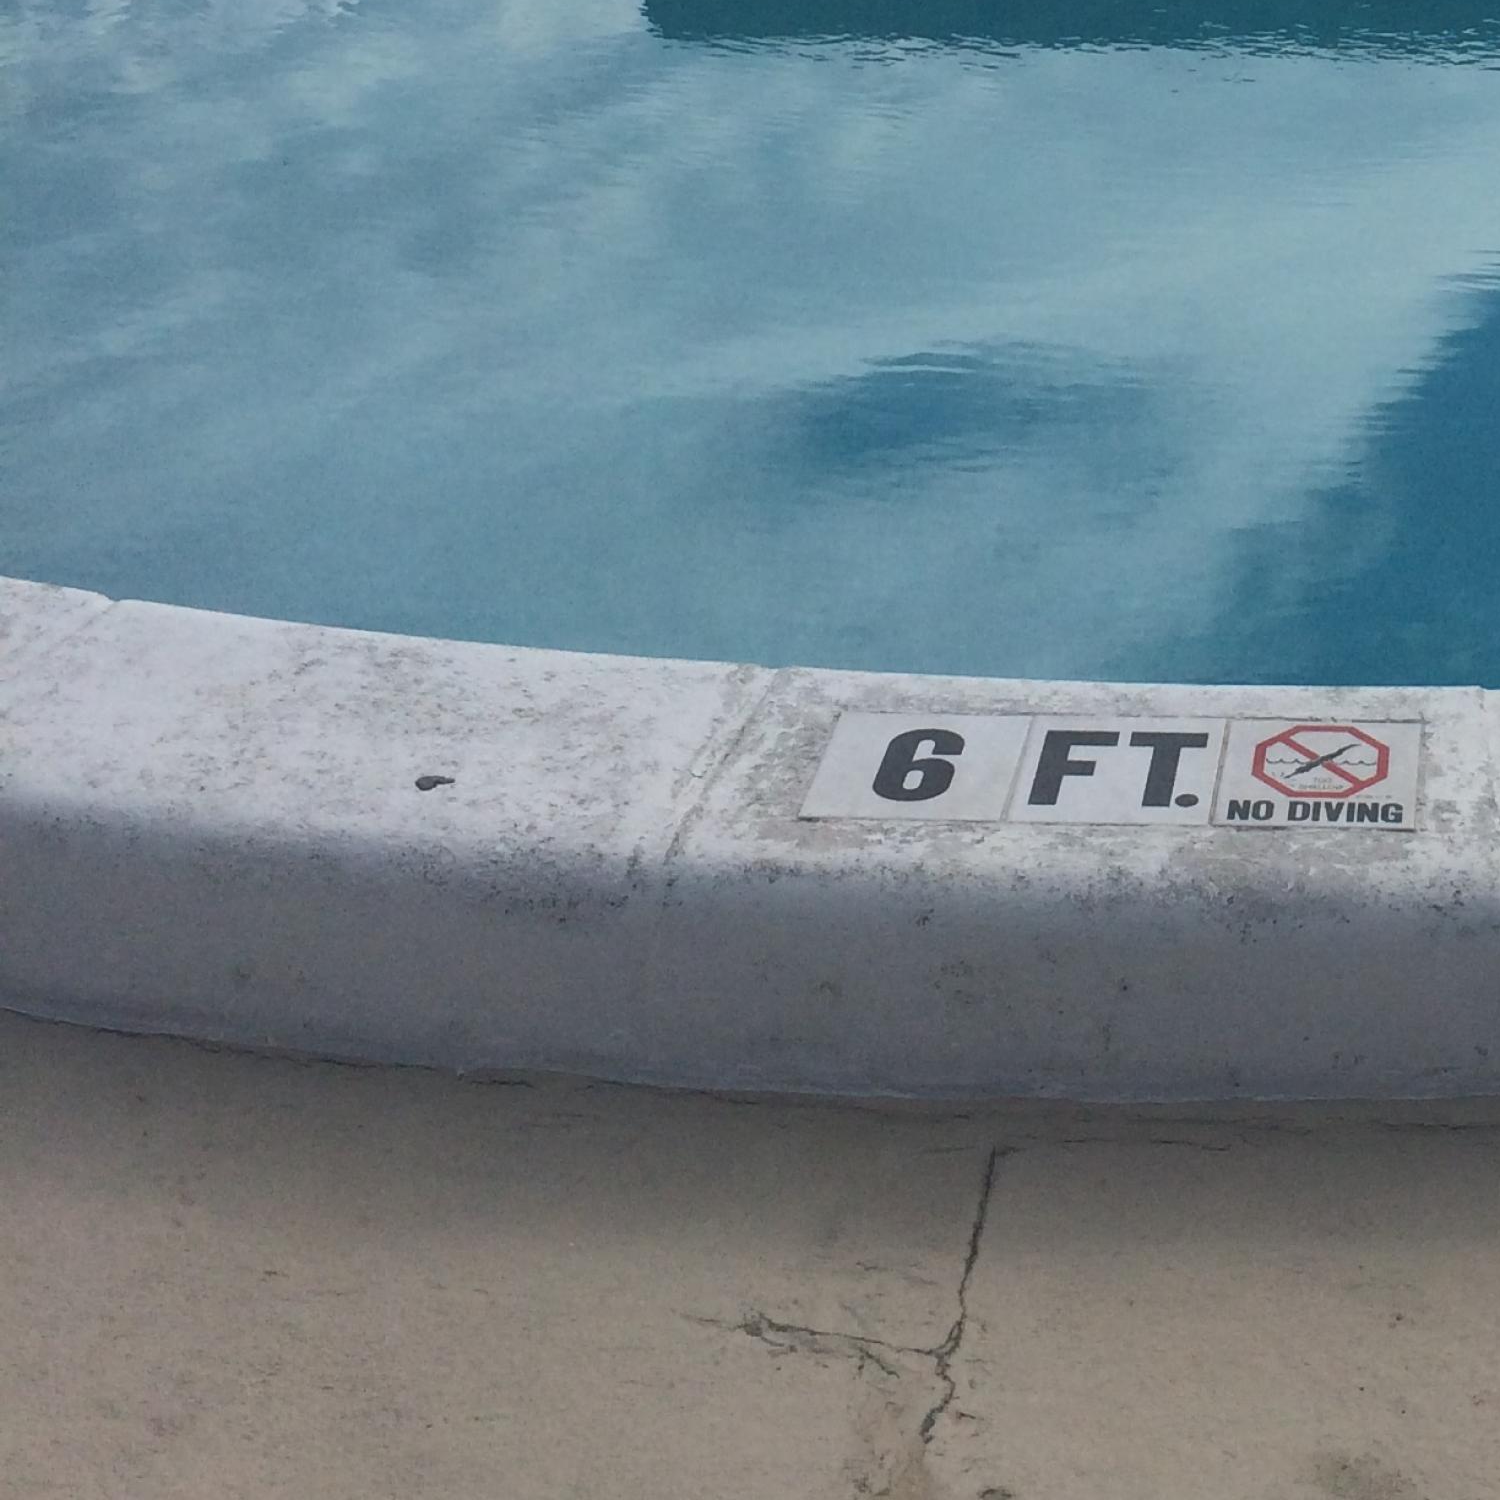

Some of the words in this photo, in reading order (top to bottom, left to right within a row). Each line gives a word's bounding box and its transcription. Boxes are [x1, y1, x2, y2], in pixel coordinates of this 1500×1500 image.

[872, 728, 965, 802] 6
[1027, 730, 1209, 808] FT.
[1227, 800, 1275, 820] NO
[1286, 801, 1404, 823] DIVING
